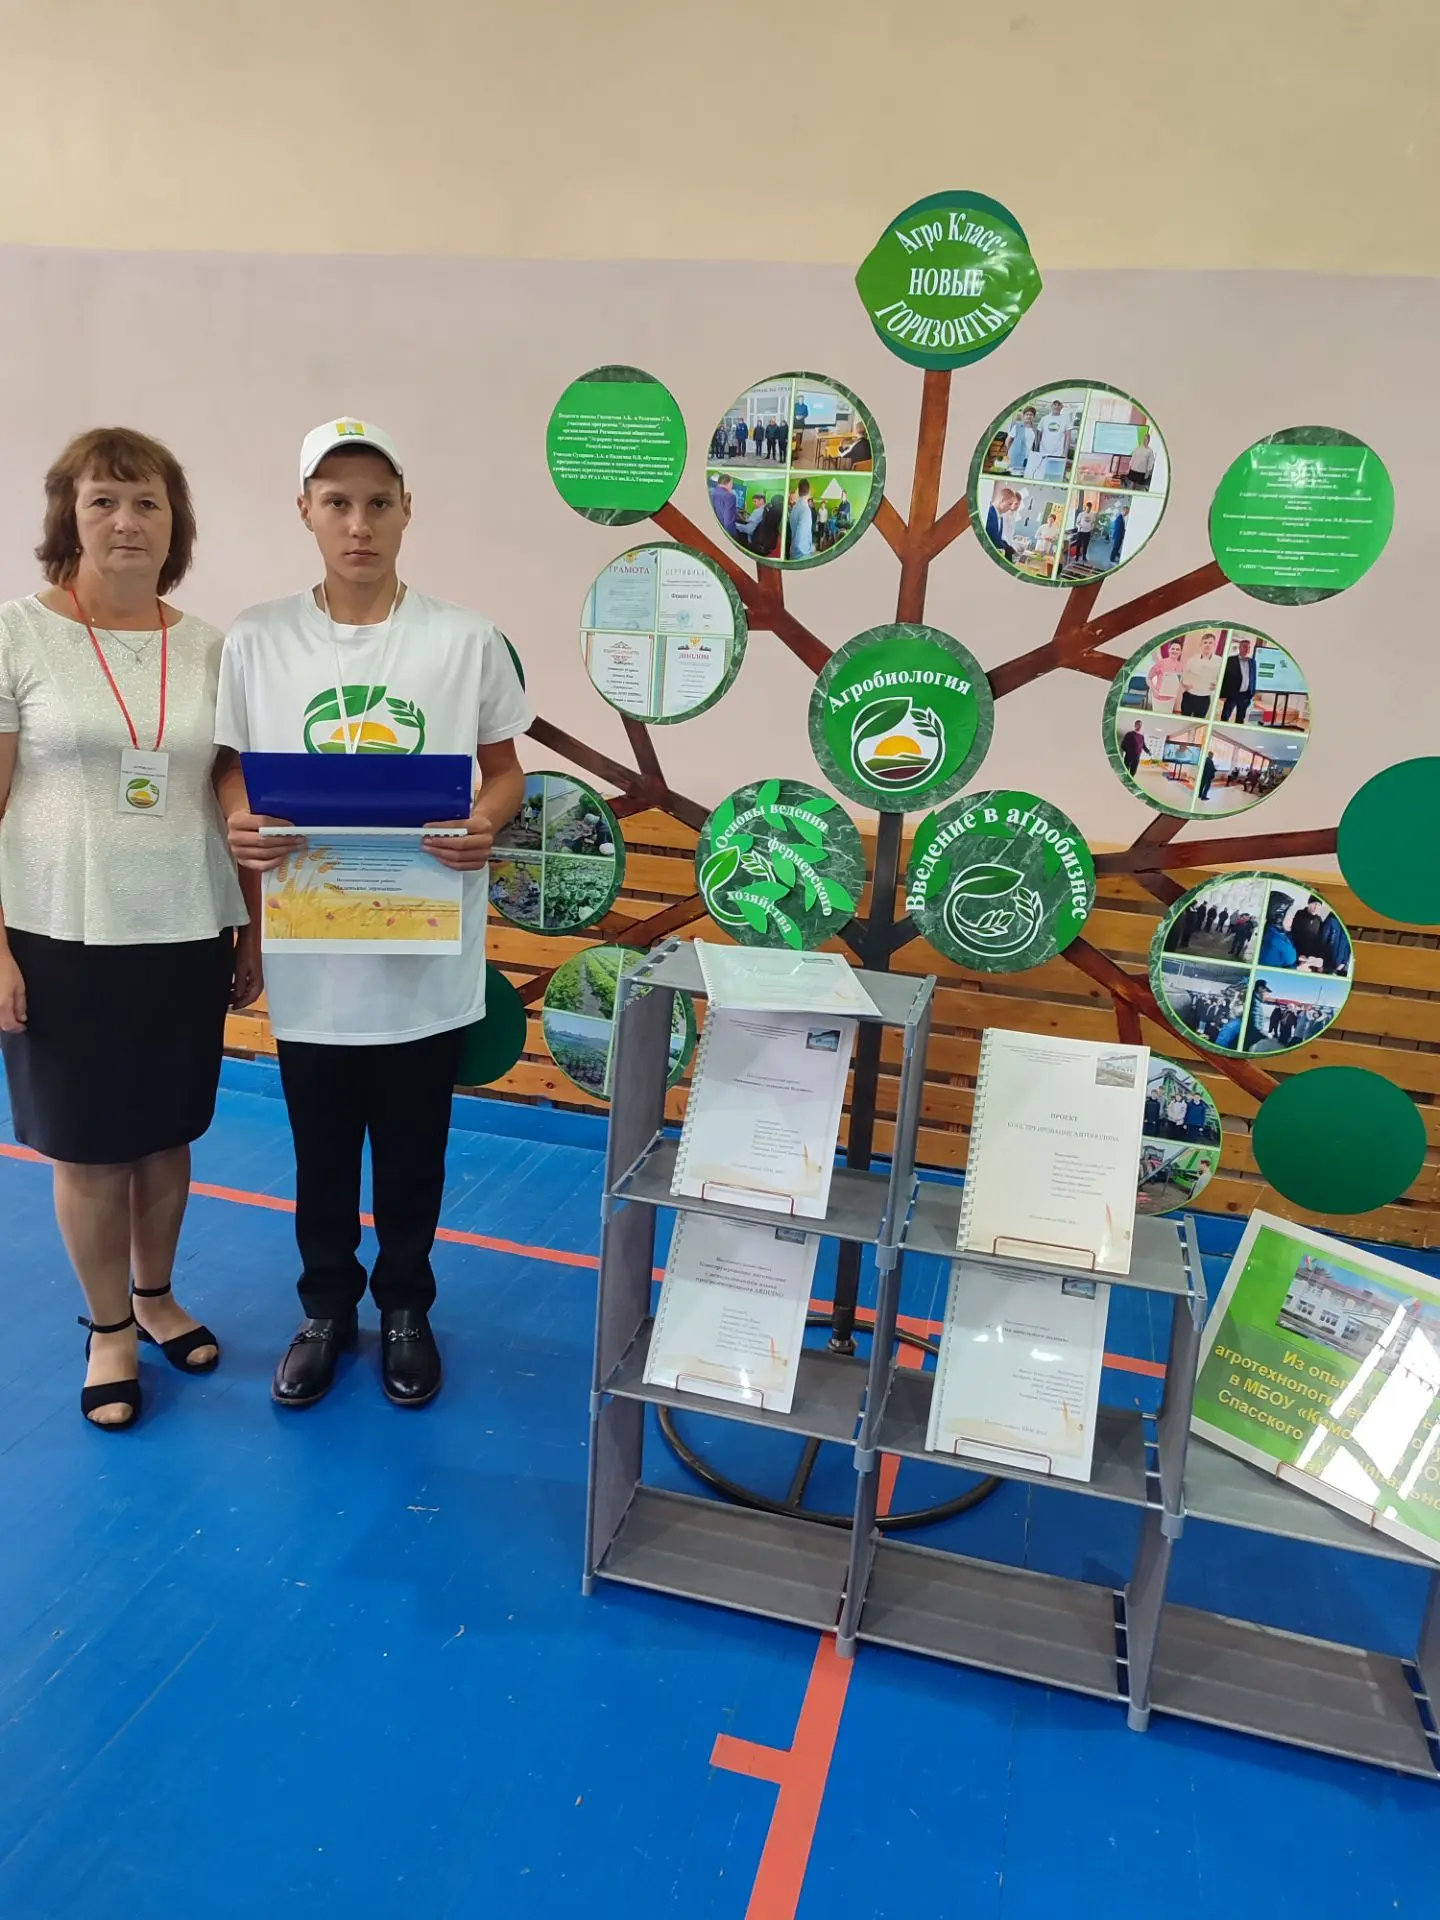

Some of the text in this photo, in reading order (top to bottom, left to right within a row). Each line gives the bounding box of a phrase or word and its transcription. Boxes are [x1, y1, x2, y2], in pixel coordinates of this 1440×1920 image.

[895, 221, 944, 255] Агро
[908, 268, 984, 297] НОВЫЕ
[874, 300, 1010, 348] ГОРИЗОНТЫ
[609, 566, 650, 574] ГРАМОТА
[828, 670, 972, 714] Агробиология
[715, 804, 829, 848] Основы ведения
[767, 837, 832, 916] фермерского
[905, 808, 1088, 920] Введение в агробизнес
[726, 891, 792, 934] хозяйства
[1050, 1113, 1078, 1122] ПРОЕКТ
[1282, 1350, 1306, 1371] Из
[1229, 1374, 1240, 1386] в
[1243, 1378, 1295, 1410] МБОУ
[1218, 1390, 1304, 1440] Спасского
